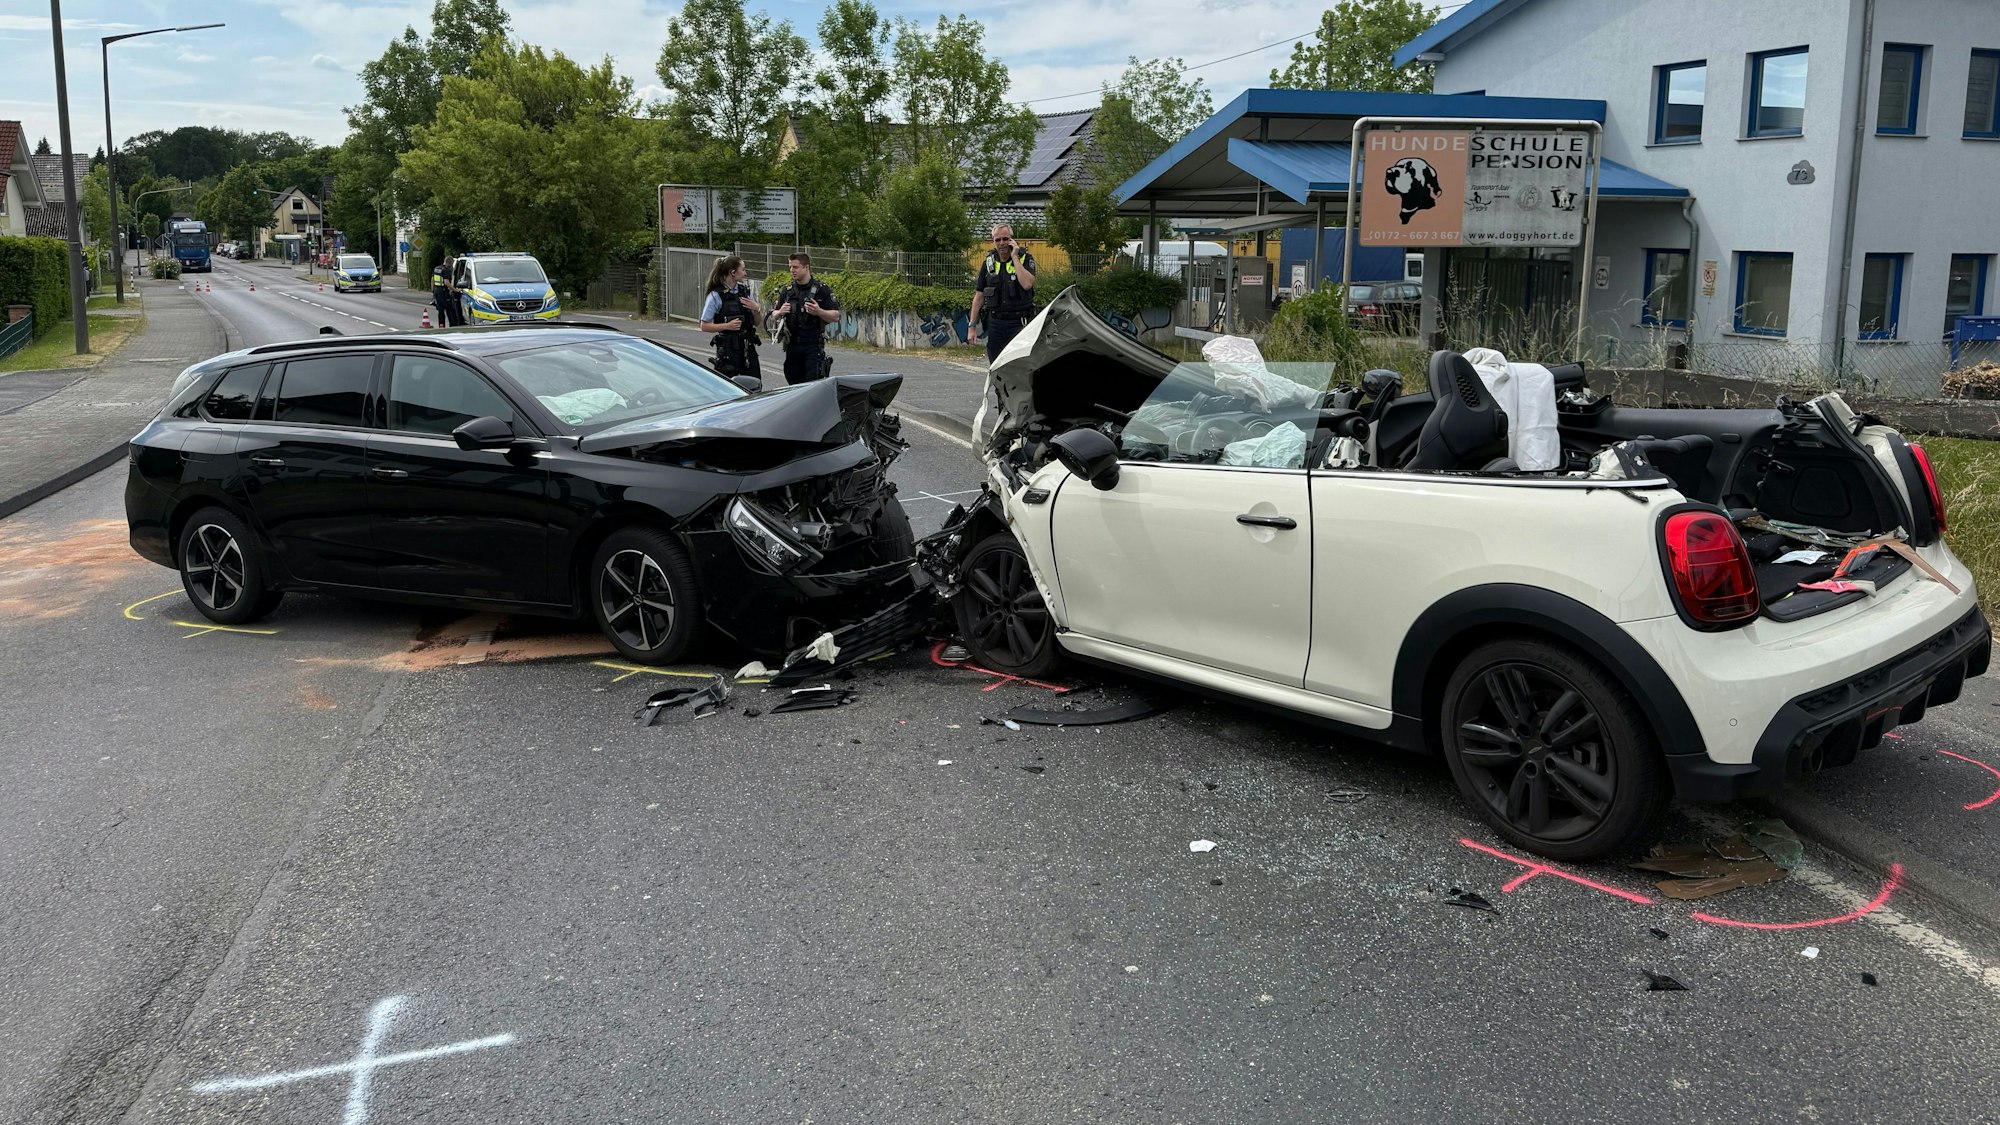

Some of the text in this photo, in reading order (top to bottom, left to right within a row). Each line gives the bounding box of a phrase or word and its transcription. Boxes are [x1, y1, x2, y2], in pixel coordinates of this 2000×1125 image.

[1471, 154, 1582, 169] PENSION
[1793, 168, 1808, 181] 73
[1409, 231, 1429, 240] 667
[1431, 231, 1437, 240] 3
[1440, 231, 1460, 240] 667
[1468, 230, 1575, 241] www.doggyhort.de
[1294, 284, 1302, 296] 10
